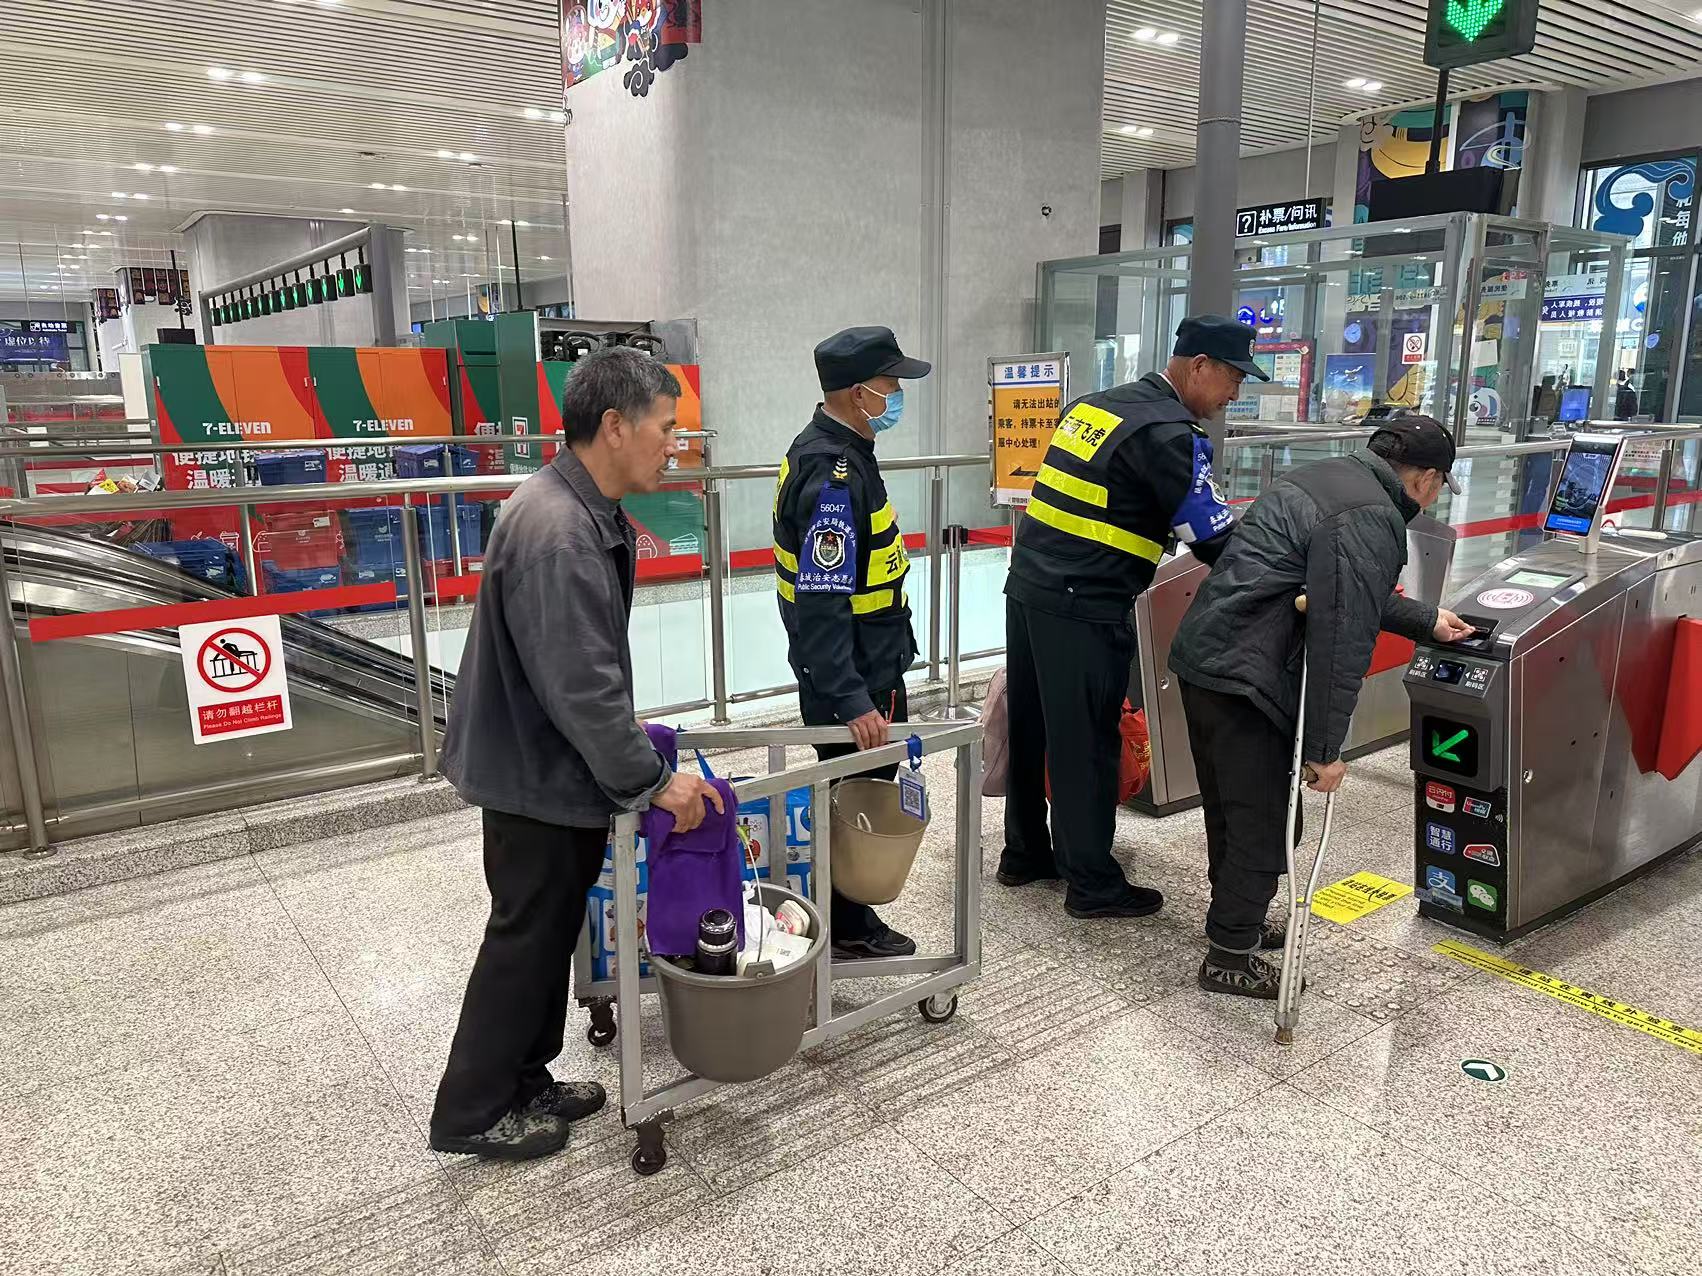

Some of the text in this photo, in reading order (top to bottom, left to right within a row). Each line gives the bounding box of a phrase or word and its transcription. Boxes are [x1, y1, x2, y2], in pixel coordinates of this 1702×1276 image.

[1259, 204, 1317, 225] 补票/问讯
[1004, 364, 1054, 379] 温馨提示
[203, 421, 271, 435] 7-ELEVEN
[353, 418, 414, 431] 7-ELEVEN
[820, 504, 845, 512] 56047
[810, 583, 831, 591] Security
[203, 700, 279, 720] 请勿翻越栏杆
[1430, 825, 1452, 840] 智慧
[1430, 836, 1452, 851] 通行
[1450, 950, 1476, 964] Please
[1479, 962, 1504, 974] stand
[1506, 972, 1538, 987] behind
[1540, 985, 1556, 994] the
[1558, 993, 1590, 1007] yellow
[1626, 1019, 1644, 1029] get
[1647, 1027, 1671, 1038] your
